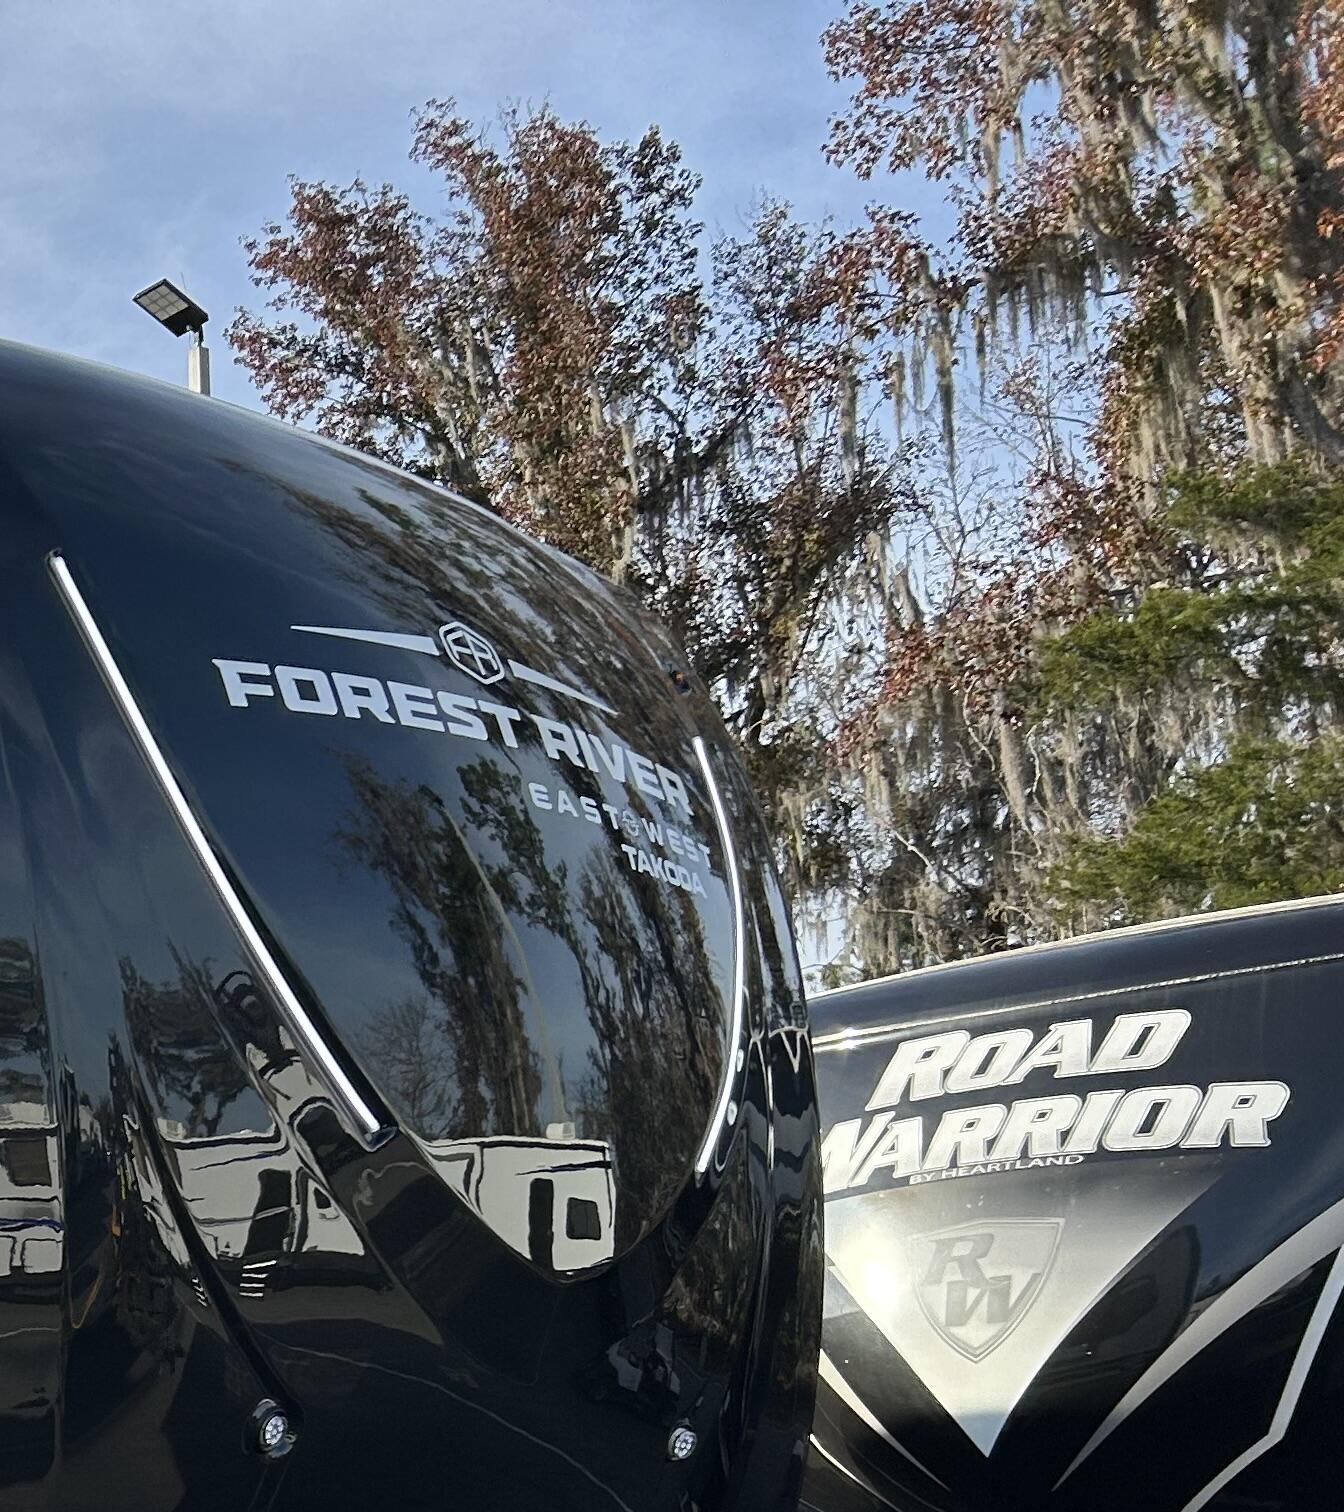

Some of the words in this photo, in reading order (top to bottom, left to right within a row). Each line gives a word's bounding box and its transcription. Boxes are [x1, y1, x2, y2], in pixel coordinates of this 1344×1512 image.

[212, 657, 520, 748] FOREST
[531, 712, 694, 818] RIVER
[528, 782, 620, 830] EAST
[641, 817, 712, 868] WEST
[621, 843, 708, 899] TAKODA
[865, 1008, 1192, 1111] ROAD
[909, 1169, 938, 1185] BY
[941, 1154, 1085, 1179] HEARTLAND
